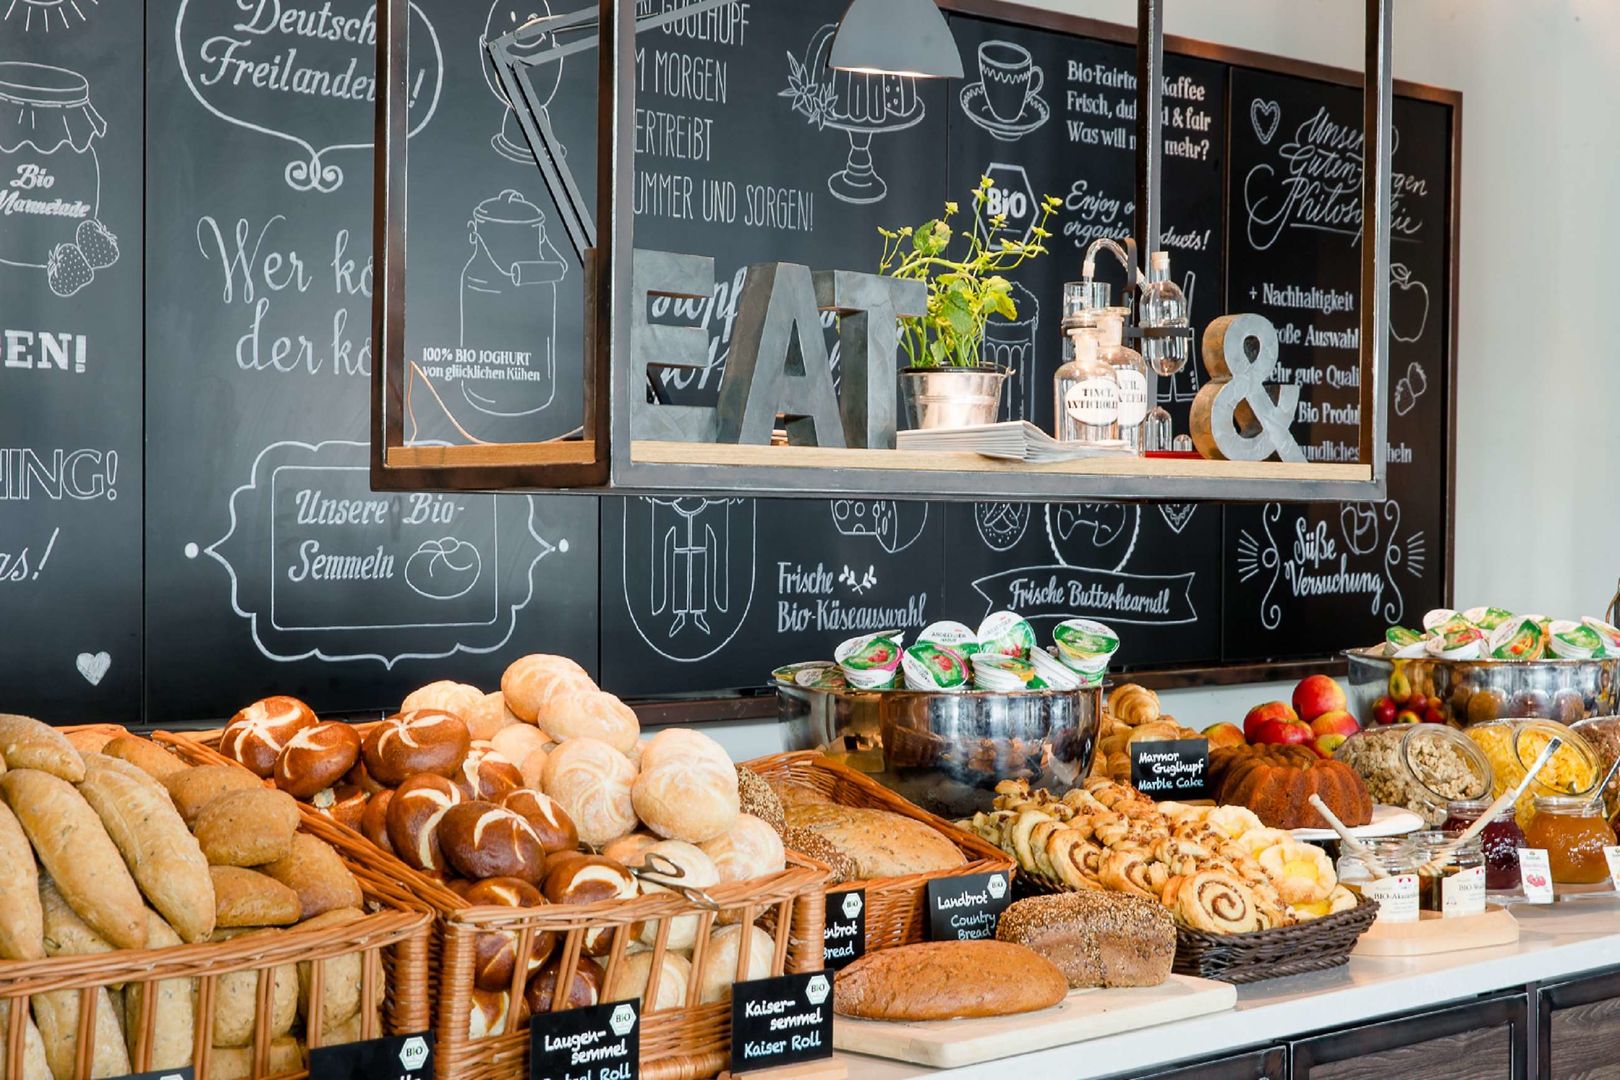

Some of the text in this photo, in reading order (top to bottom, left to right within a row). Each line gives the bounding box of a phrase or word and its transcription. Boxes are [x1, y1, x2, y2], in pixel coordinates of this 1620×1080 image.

[655, 49, 727, 104] MORGEN
[1161, 75, 1206, 101] Kaffee
[1066, 90, 1112, 119] Frisch,
[1185, 107, 1212, 131] fair
[1066, 119, 1099, 145] Was
[1100, 127, 1126, 149] will
[1165, 136, 1209, 160] mehr?
[10, 164, 55, 189] Bio
[633, 171, 814, 232] UMMER UND SORGEN!
[1065, 180, 1121, 222] Enjoy
[1063, 221, 1130, 248] organic
[1160, 226, 1211, 250] ducts!
[197, 214, 313, 304] Wer
[1262, 283, 1354, 314] Nachhaltigkeit
[236, 297, 323, 375] der
[1304, 324, 1359, 349] Auswahl
[3, 329, 87, 373] EN!
[422, 347, 532, 366] 100% BIO JOGHURT
[630, 248, 928, 452] EAT
[422, 364, 541, 382] von glücklichen Kühen
[1266, 361, 1360, 389] ehr gute Quali
[1298, 401, 1360, 425] Bio Produ
[295, 488, 465, 525] Unsere Bio-
[1293, 516, 1337, 569] Süße
[288, 539, 395, 582] Semmeln
[777, 562, 834, 594] Frische
[1284, 552, 1384, 616] Versuchung
[1008, 575, 1065, 611] Frische
[777, 592, 927, 633] Bio-Käseauswahl
[1138, 752, 1180, 764] Marmor
[1152, 758, 1204, 778] Guglhupf
[1138, 776, 1204, 790] Marble Cake
[937, 889, 988, 910] Landbrot
[823, 920, 858, 940] enbrot
[951, 910, 996, 928] Country
[957, 924, 992, 940] Bread
[745, 1000, 796, 1018] Kaiser-
[769, 1007, 823, 1031] semmel
[406, 1046, 423, 1057] BIO
[544, 1030, 607, 1053] Laugen-
[571, 1038, 628, 1065] semmel
[744, 1029, 822, 1058] Kaiser Roll
